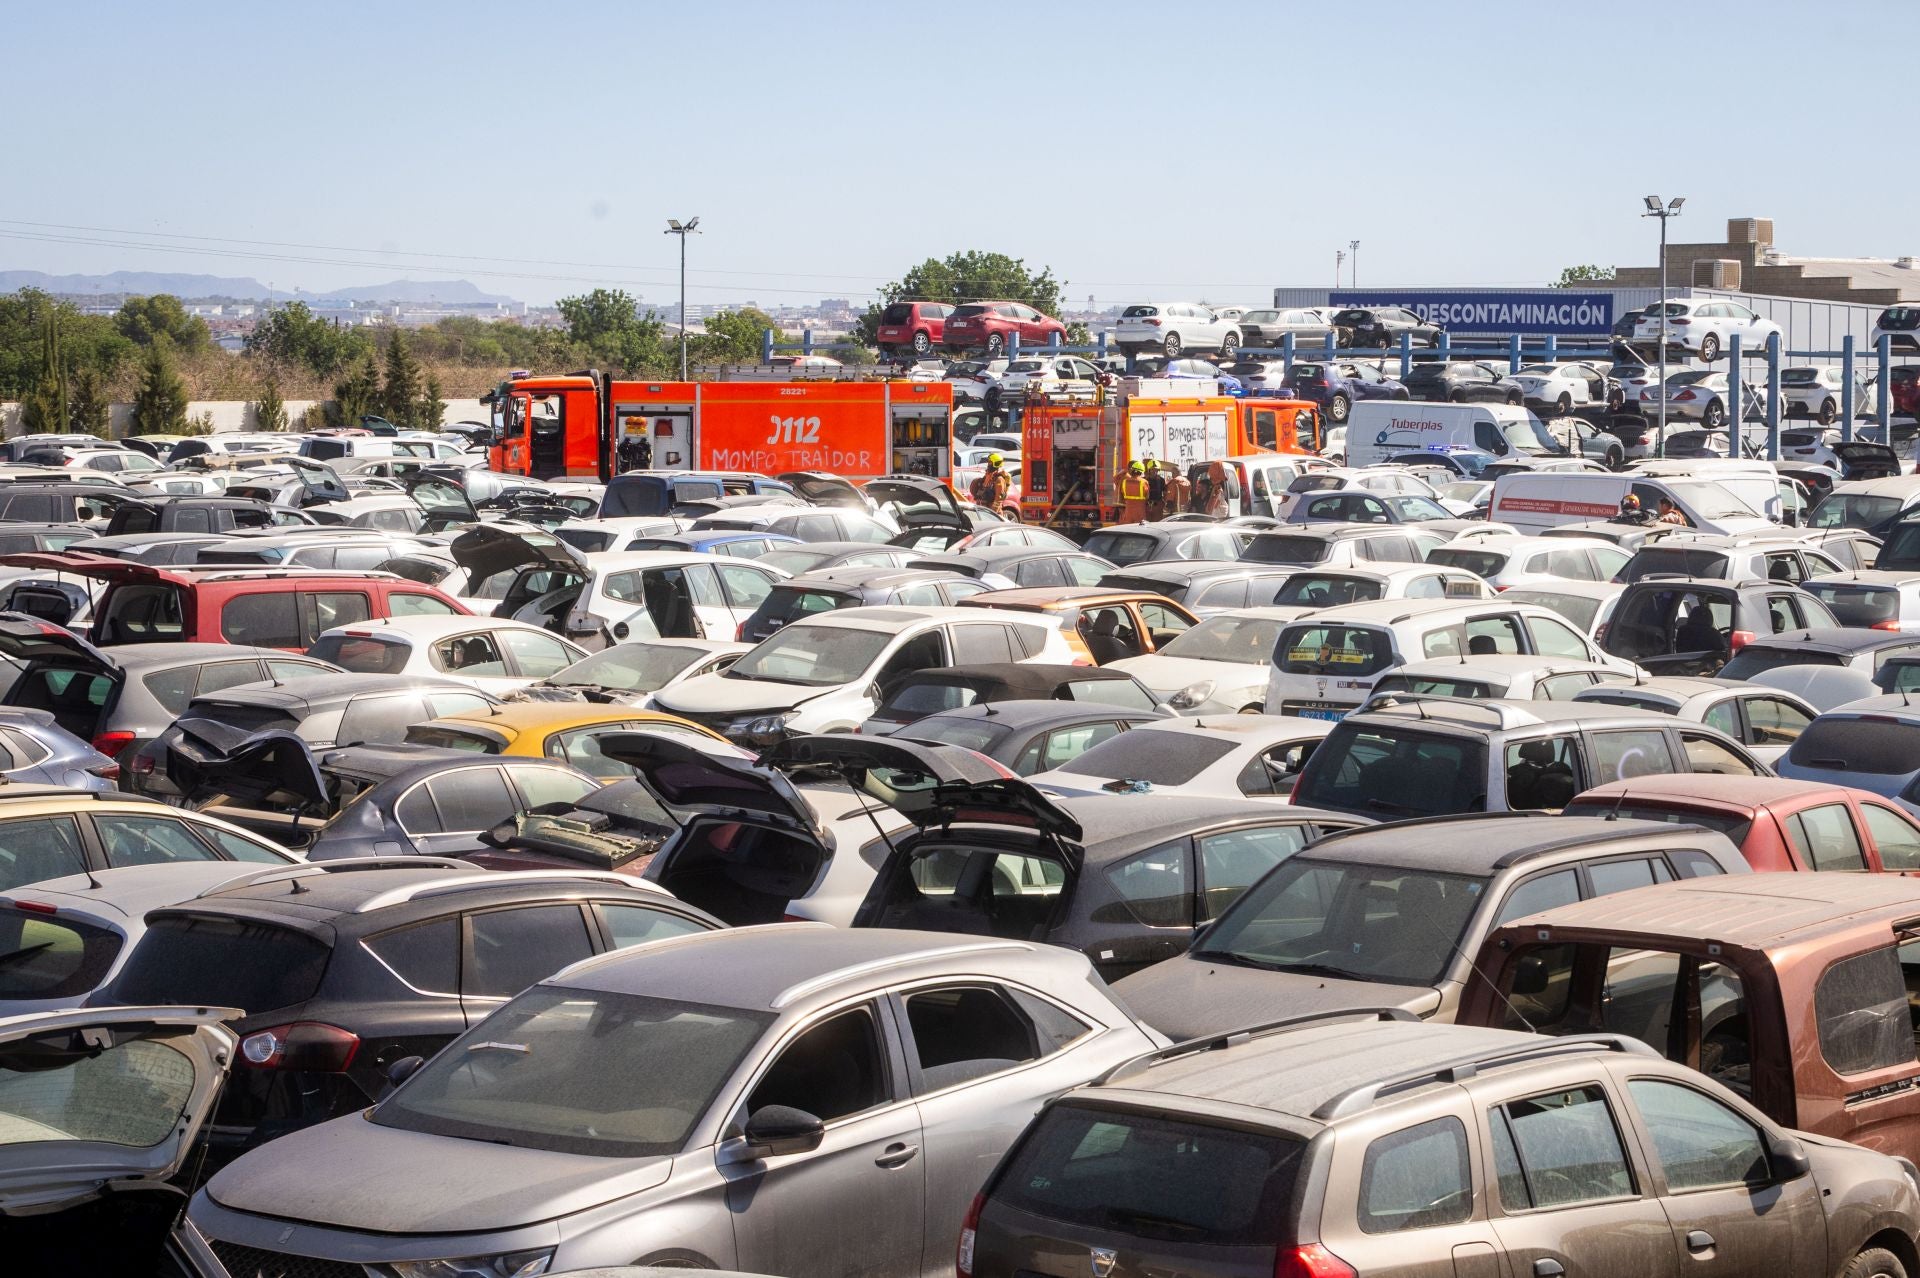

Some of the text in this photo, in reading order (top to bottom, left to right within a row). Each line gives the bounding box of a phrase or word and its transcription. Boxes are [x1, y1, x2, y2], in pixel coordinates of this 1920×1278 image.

[1416, 300, 1605, 325] DESCONTAMINACIÓN
[782, 416, 821, 444] 112
[1391, 419, 1443, 432] Tuberplas
[712, 448, 777, 470] MOMPO
